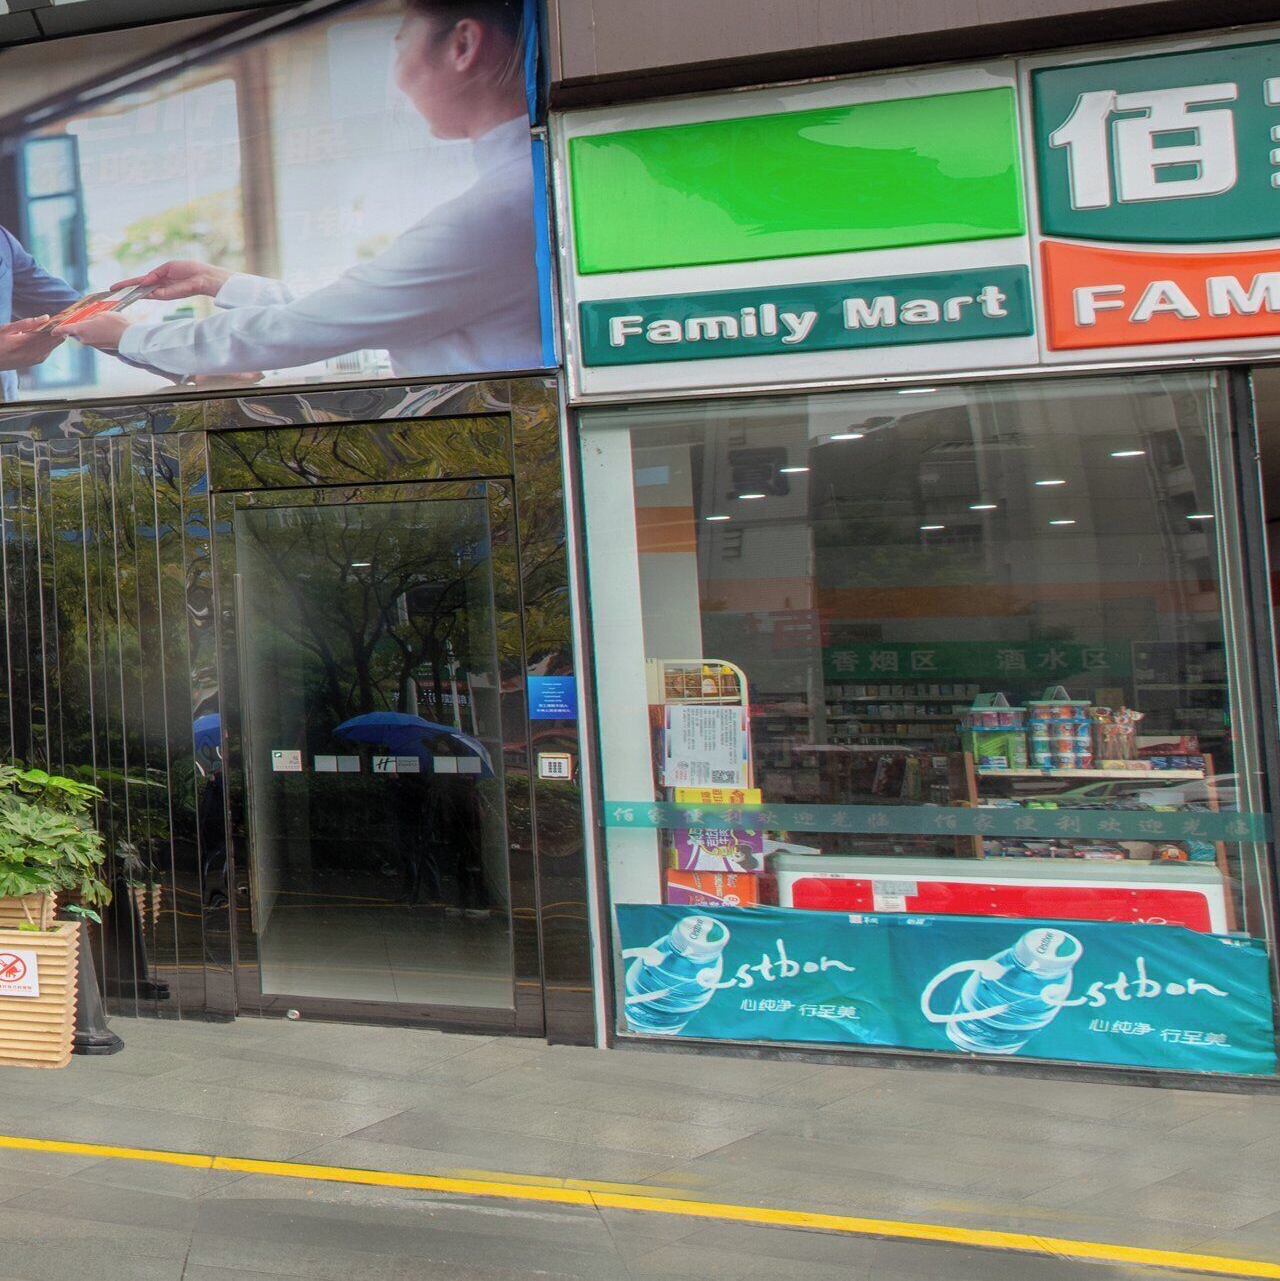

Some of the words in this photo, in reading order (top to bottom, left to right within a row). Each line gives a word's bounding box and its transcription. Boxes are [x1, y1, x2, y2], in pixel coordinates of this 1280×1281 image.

[1049, 77, 1280, 211] 佰
[608, 302, 817, 348] Family
[843, 285, 1008, 329] Mart
[1073, 271, 1280, 327] FAM
[830, 650, 938, 673] 香烟区
[997, 648, 1111, 671] 酒水区
